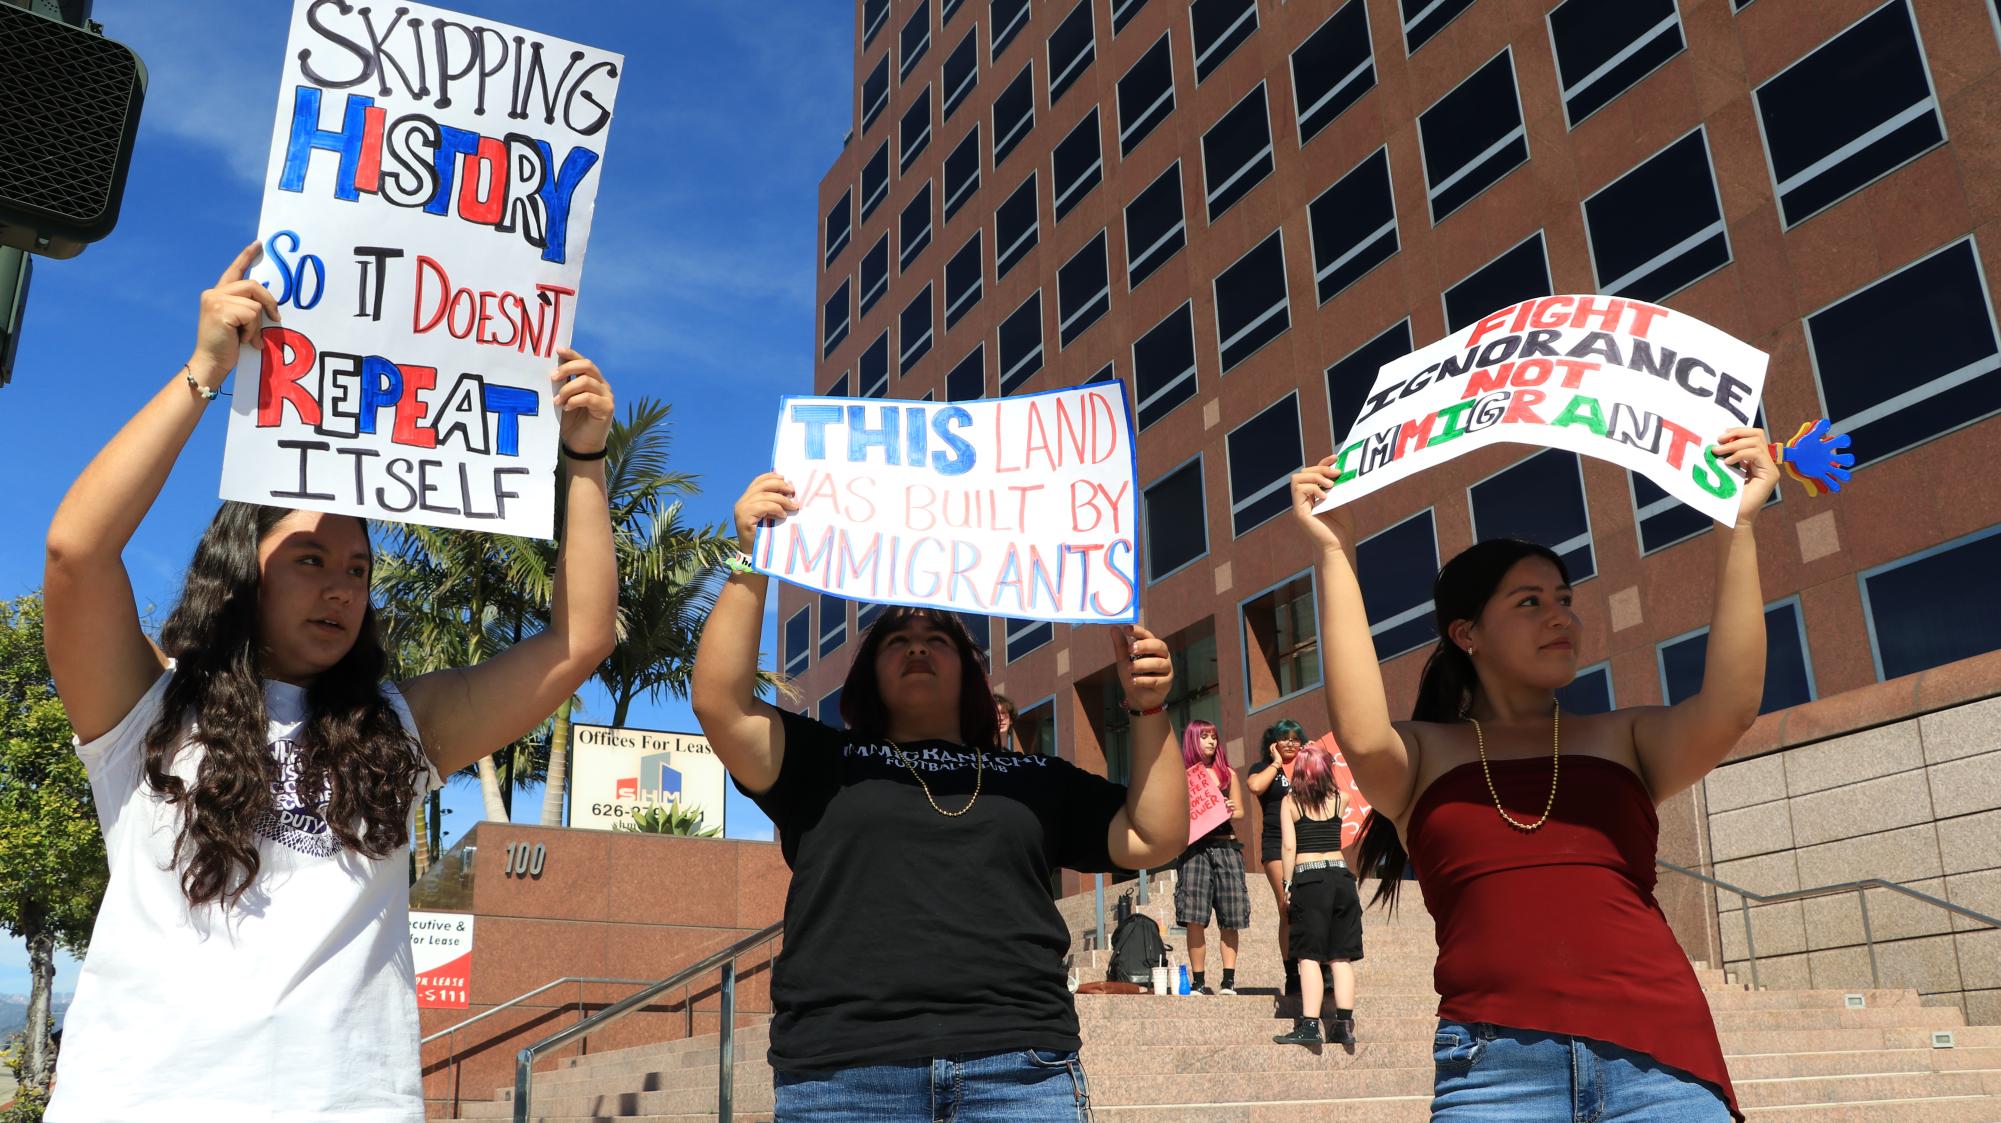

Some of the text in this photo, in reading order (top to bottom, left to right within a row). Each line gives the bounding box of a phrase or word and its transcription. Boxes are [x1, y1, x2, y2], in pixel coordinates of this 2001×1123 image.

[298, 0, 617, 135] SKIPPING
[279, 85, 599, 264] HISTORY
[262, 230, 325, 309] SO
[353, 246, 404, 321] IT
[1466, 296, 1669, 348] FIGHT
[256, 327, 540, 456] REPEAT
[1357, 329, 1753, 425] IGNORANCE
[1461, 359, 1602, 400] NOT
[791, 392, 1118, 476] THIS LAND
[1331, 391, 1738, 500] IMMIGRANTS
[270, 440, 529, 520] ITSELF
[905, 484, 1045, 534] BUILT
[1070, 479, 1129, 535] BY
[762, 522, 1135, 617] IMMIGRANTS
[579, 729, 714, 755] Offices For Leas
[280, 810, 324, 834] DUTY
[618, 787, 681, 803] SHM
[505, 841, 546, 877] 100
[429, 935, 460, 946] Lease
[456, 921, 466, 932] &
[432, 976, 465, 987] LEASE
